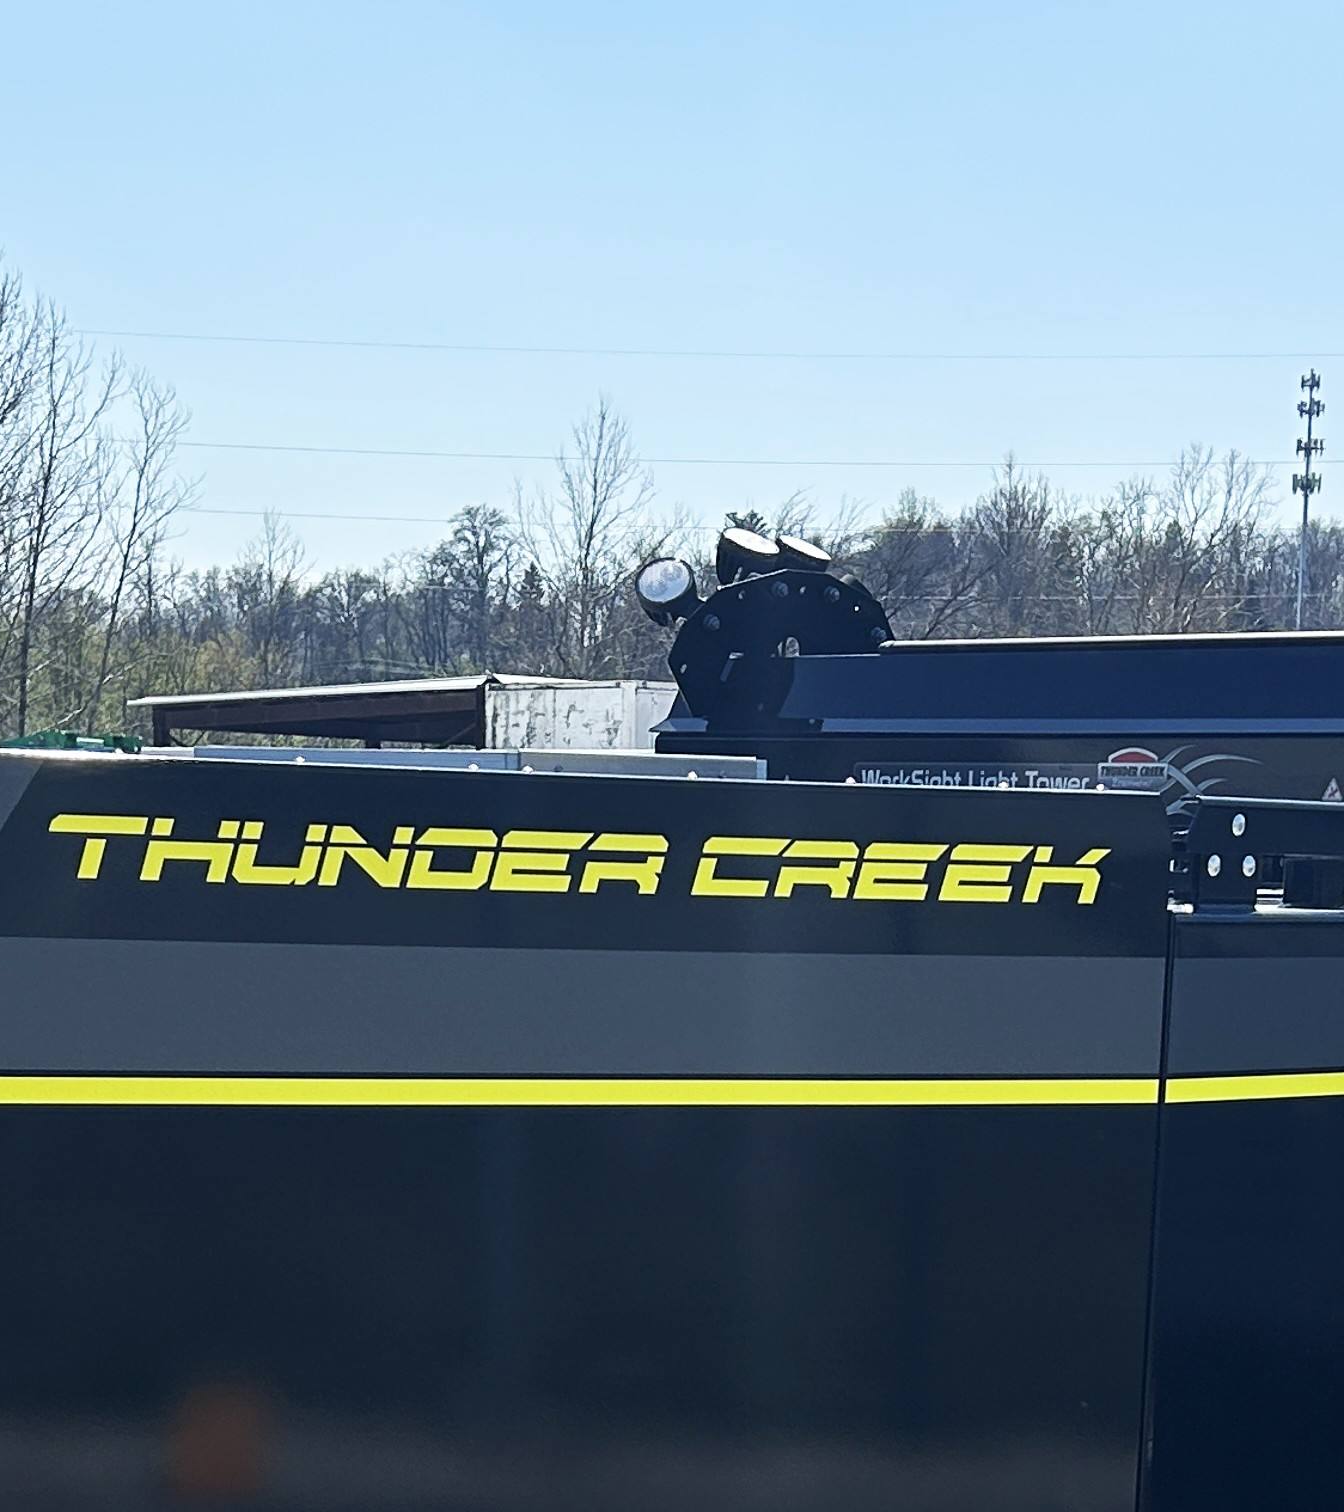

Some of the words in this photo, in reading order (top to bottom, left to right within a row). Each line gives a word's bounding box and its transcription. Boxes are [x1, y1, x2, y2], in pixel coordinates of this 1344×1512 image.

[1025, 770, 1090, 789] Tower
[47, 813, 669, 896] THUNDER
[690, 836, 1112, 905] CREEK
